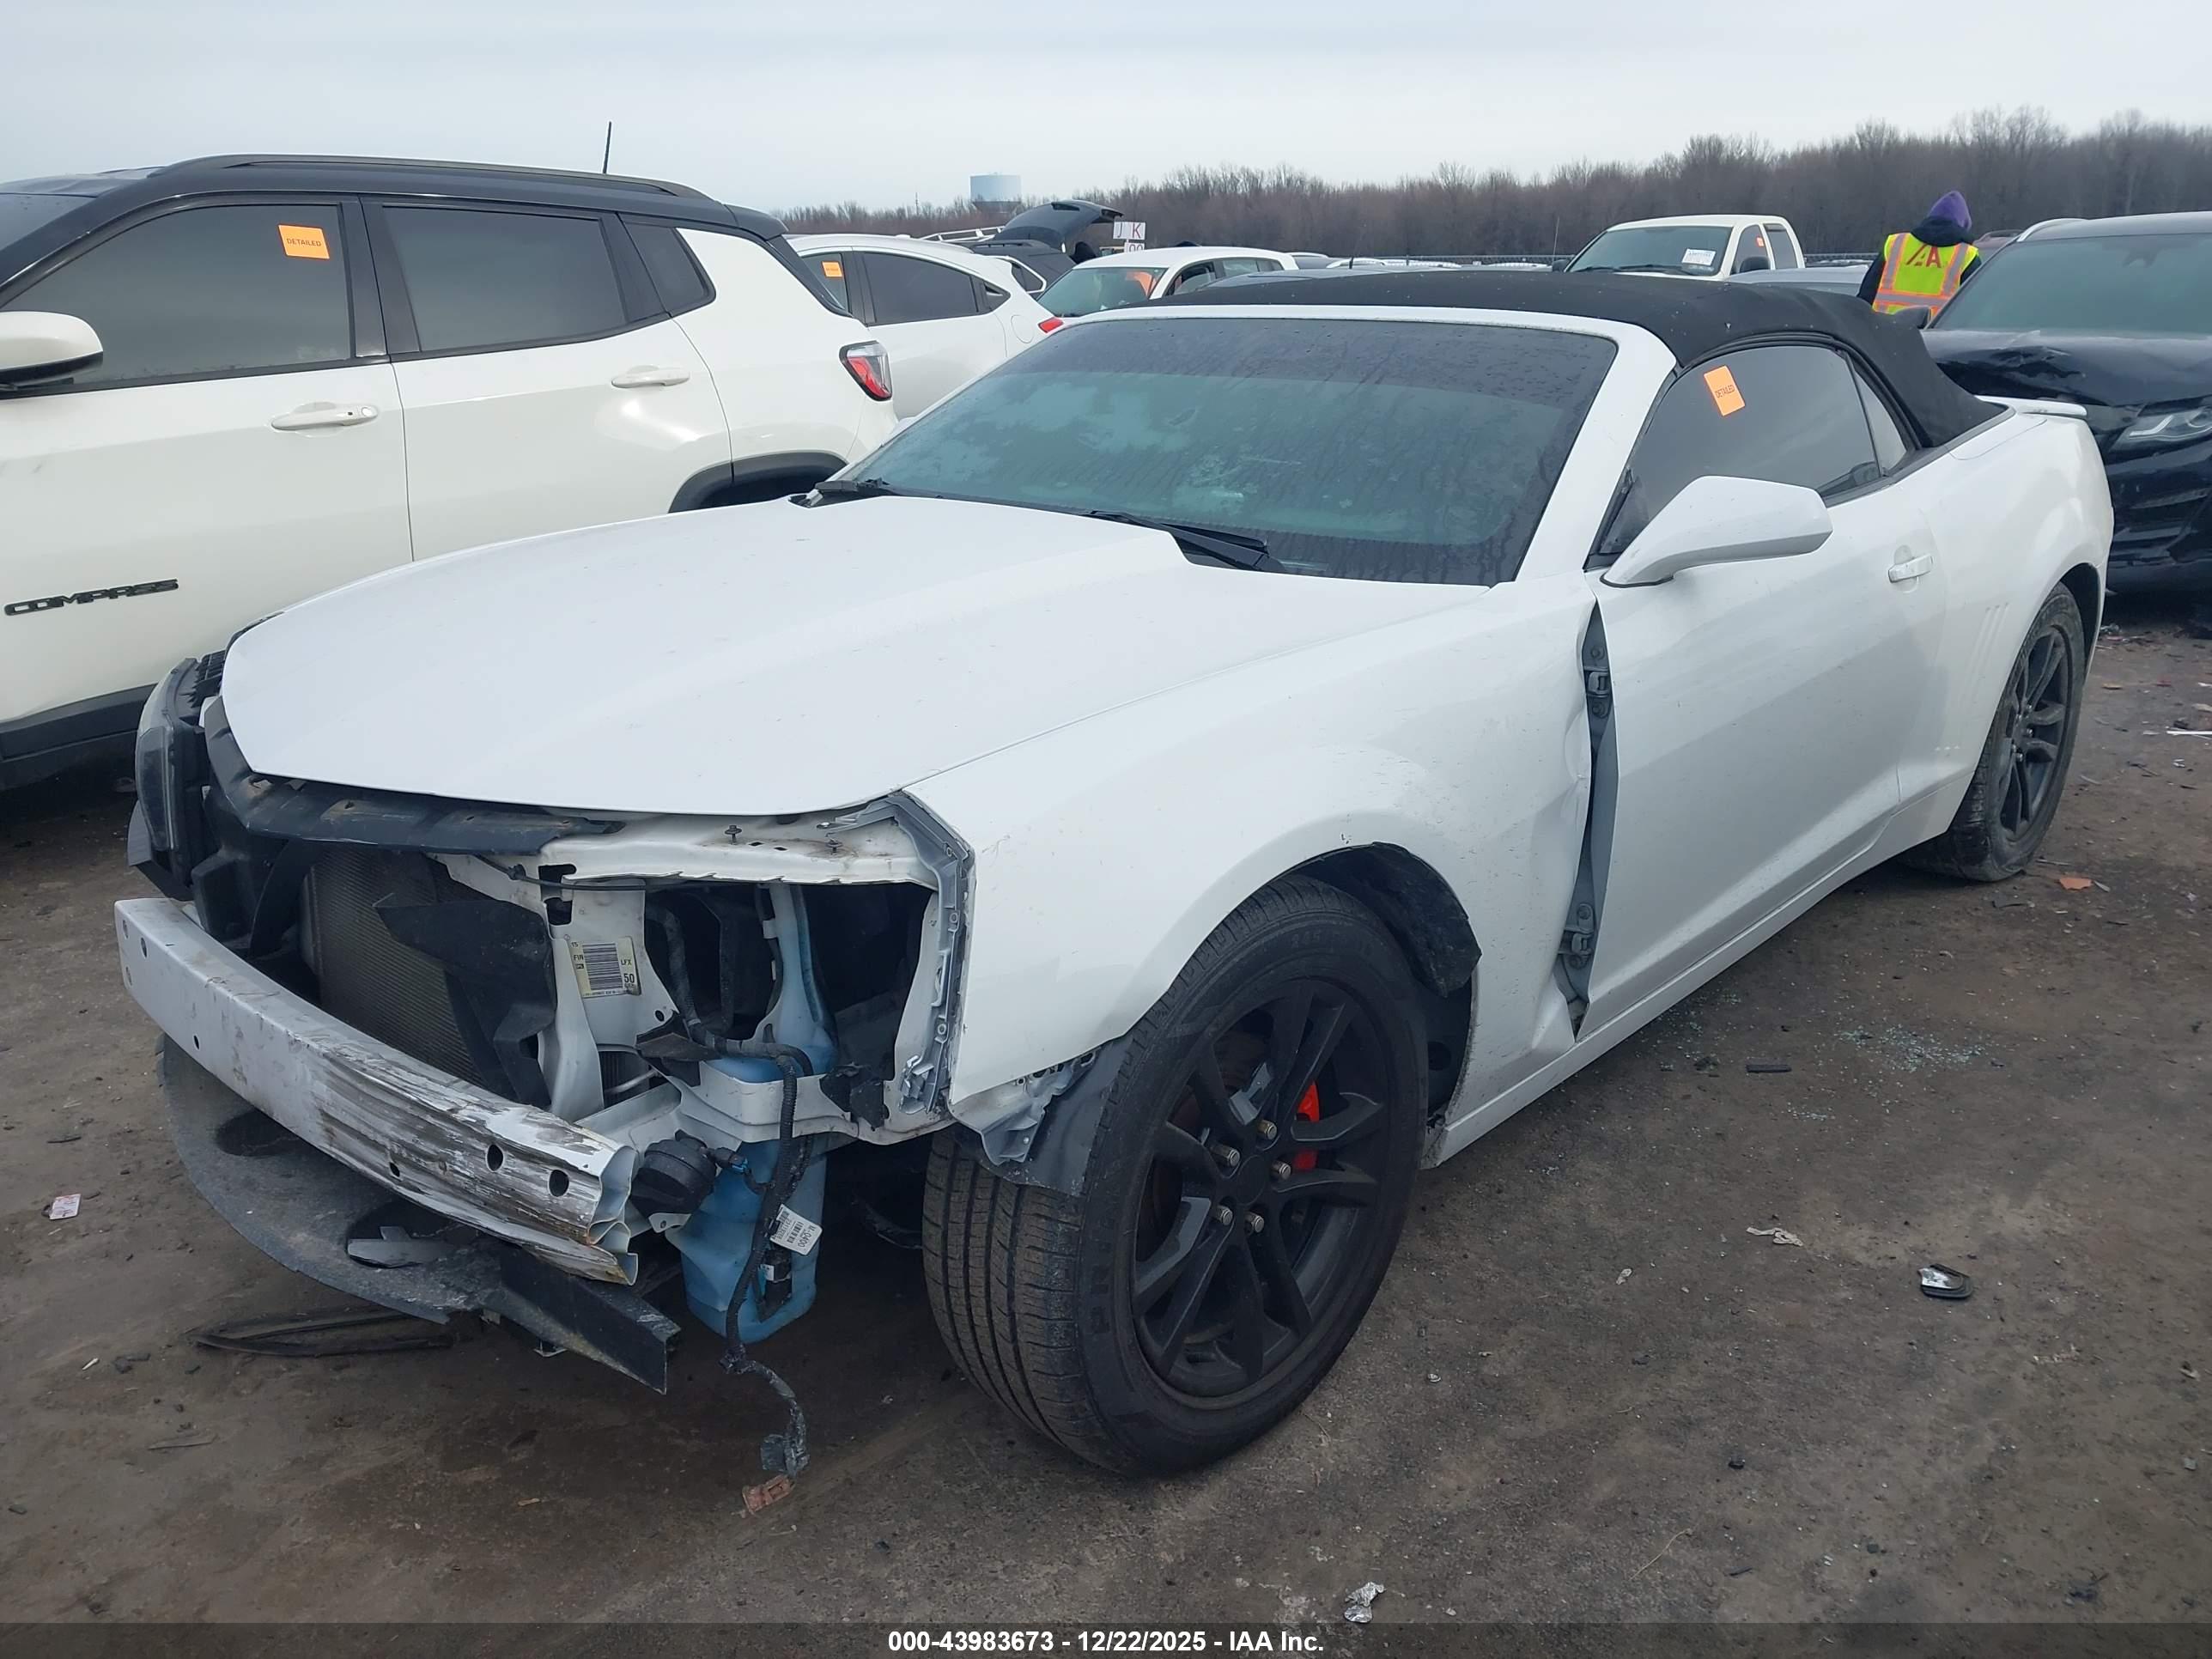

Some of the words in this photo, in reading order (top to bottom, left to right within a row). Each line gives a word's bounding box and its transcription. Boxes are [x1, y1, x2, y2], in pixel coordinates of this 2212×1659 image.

[1132, 222, 1141, 239] K
[286, 238, 322, 247] DETAILED
[623, 973, 635, 983] 50
